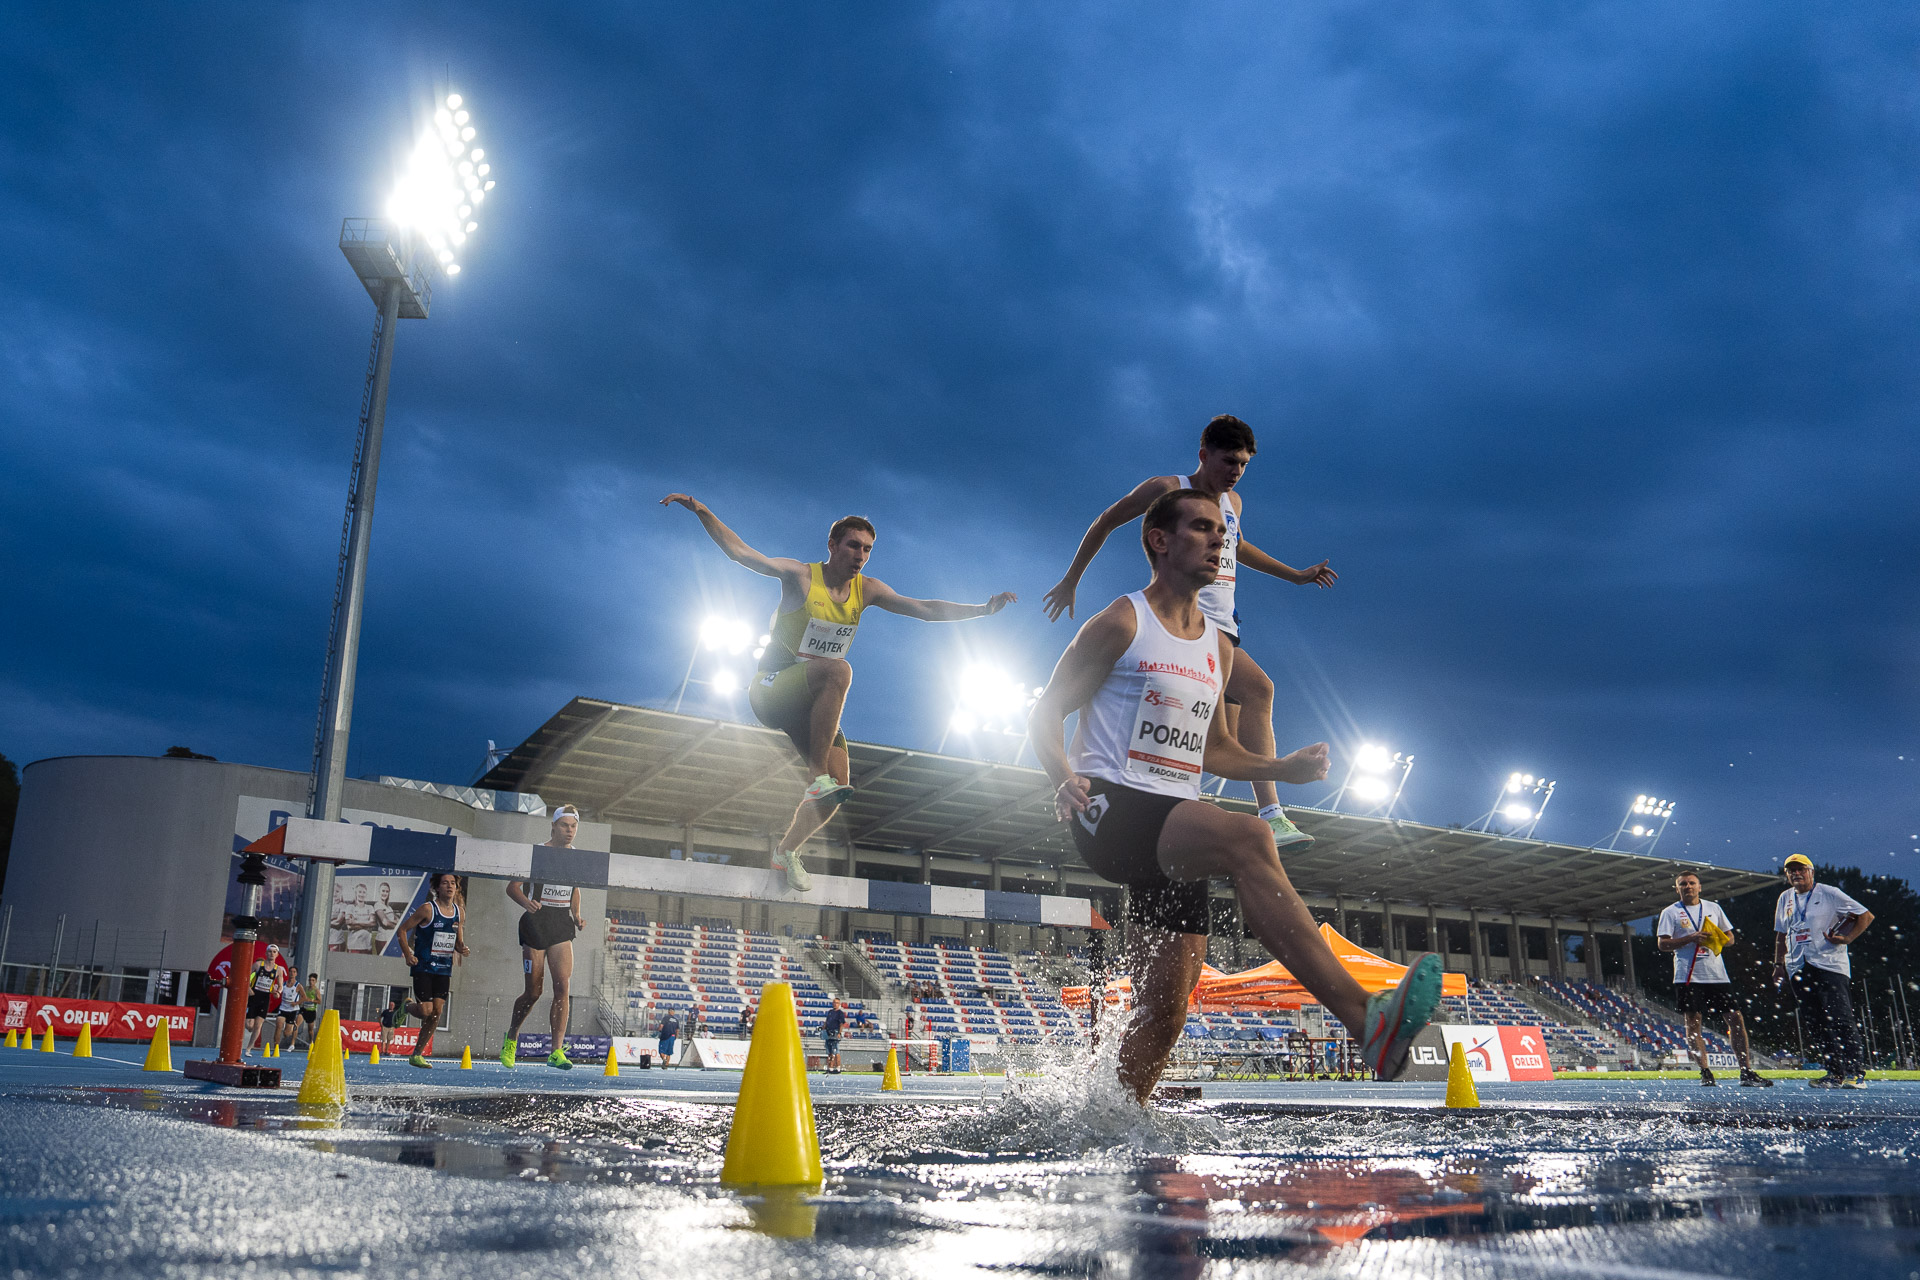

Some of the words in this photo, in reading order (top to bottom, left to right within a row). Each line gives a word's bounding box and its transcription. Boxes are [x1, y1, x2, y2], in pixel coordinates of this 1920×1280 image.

[1219, 557, 1234, 569] CKI
[836, 627, 853, 637] 652
[808, 638, 844, 653] PIĄTEK
[1191, 700, 1211, 720] 476
[1138, 720, 1204, 754] PORADA
[1149, 766, 1177, 778] RADOM
[525, 960, 530, 971] 3
[63, 1009, 109, 1026] ORLEN
[351, 1029, 387, 1043] ORLE
[390, 1034, 418, 1046] RLE
[1409, 1046, 1446, 1065] UEL
[1467, 1057, 1484, 1068] anik
[1514, 1057, 1541, 1067] ORLEN
